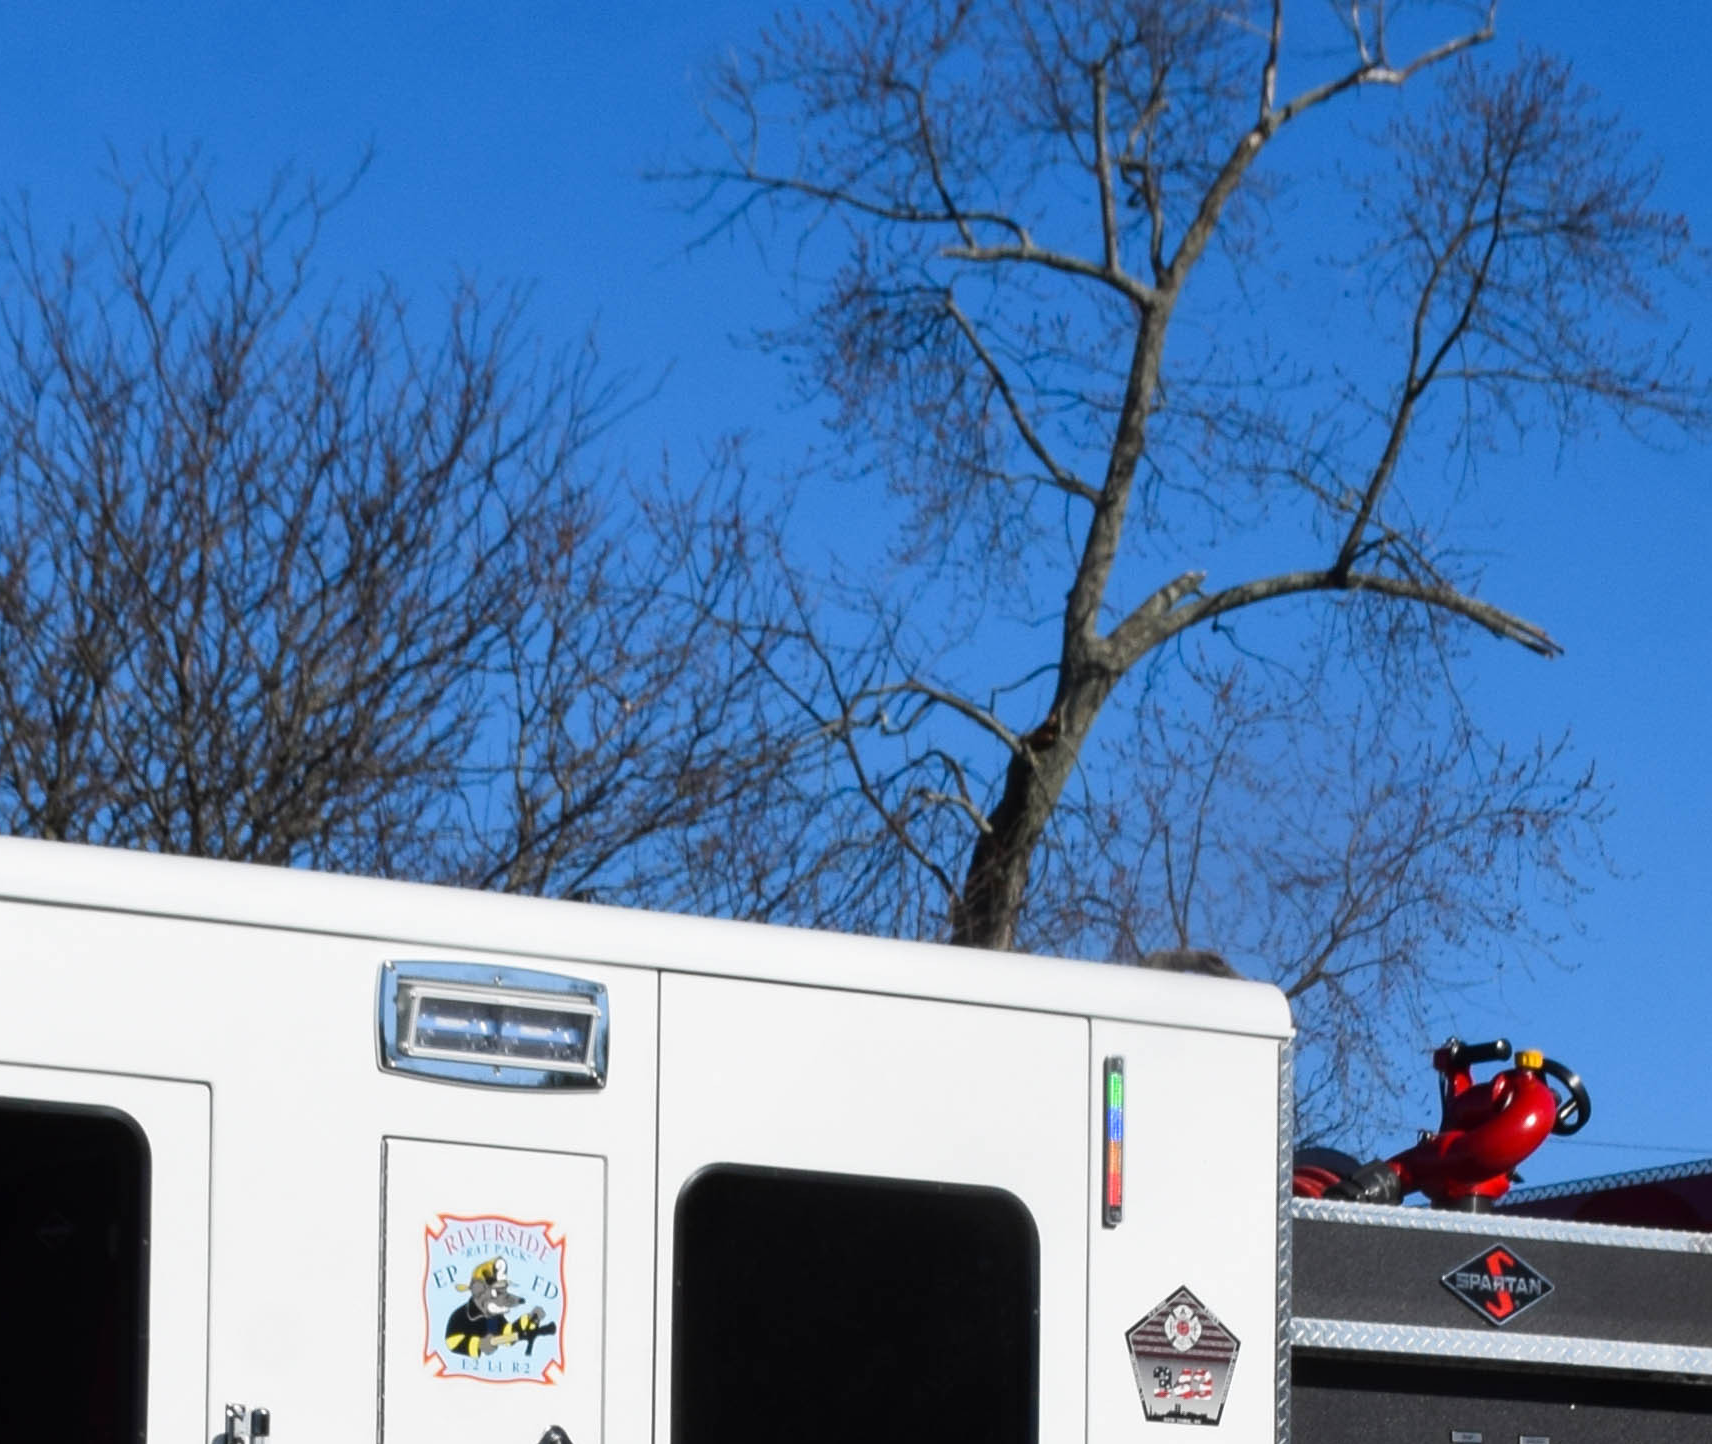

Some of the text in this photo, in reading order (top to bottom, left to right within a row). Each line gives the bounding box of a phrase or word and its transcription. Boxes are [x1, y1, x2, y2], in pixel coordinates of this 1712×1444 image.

[444, 1224, 550, 1262] RIVERSIDE
[433, 1265, 558, 1299] EP FD
[1455, 1273, 1542, 1295] SPARTAN
